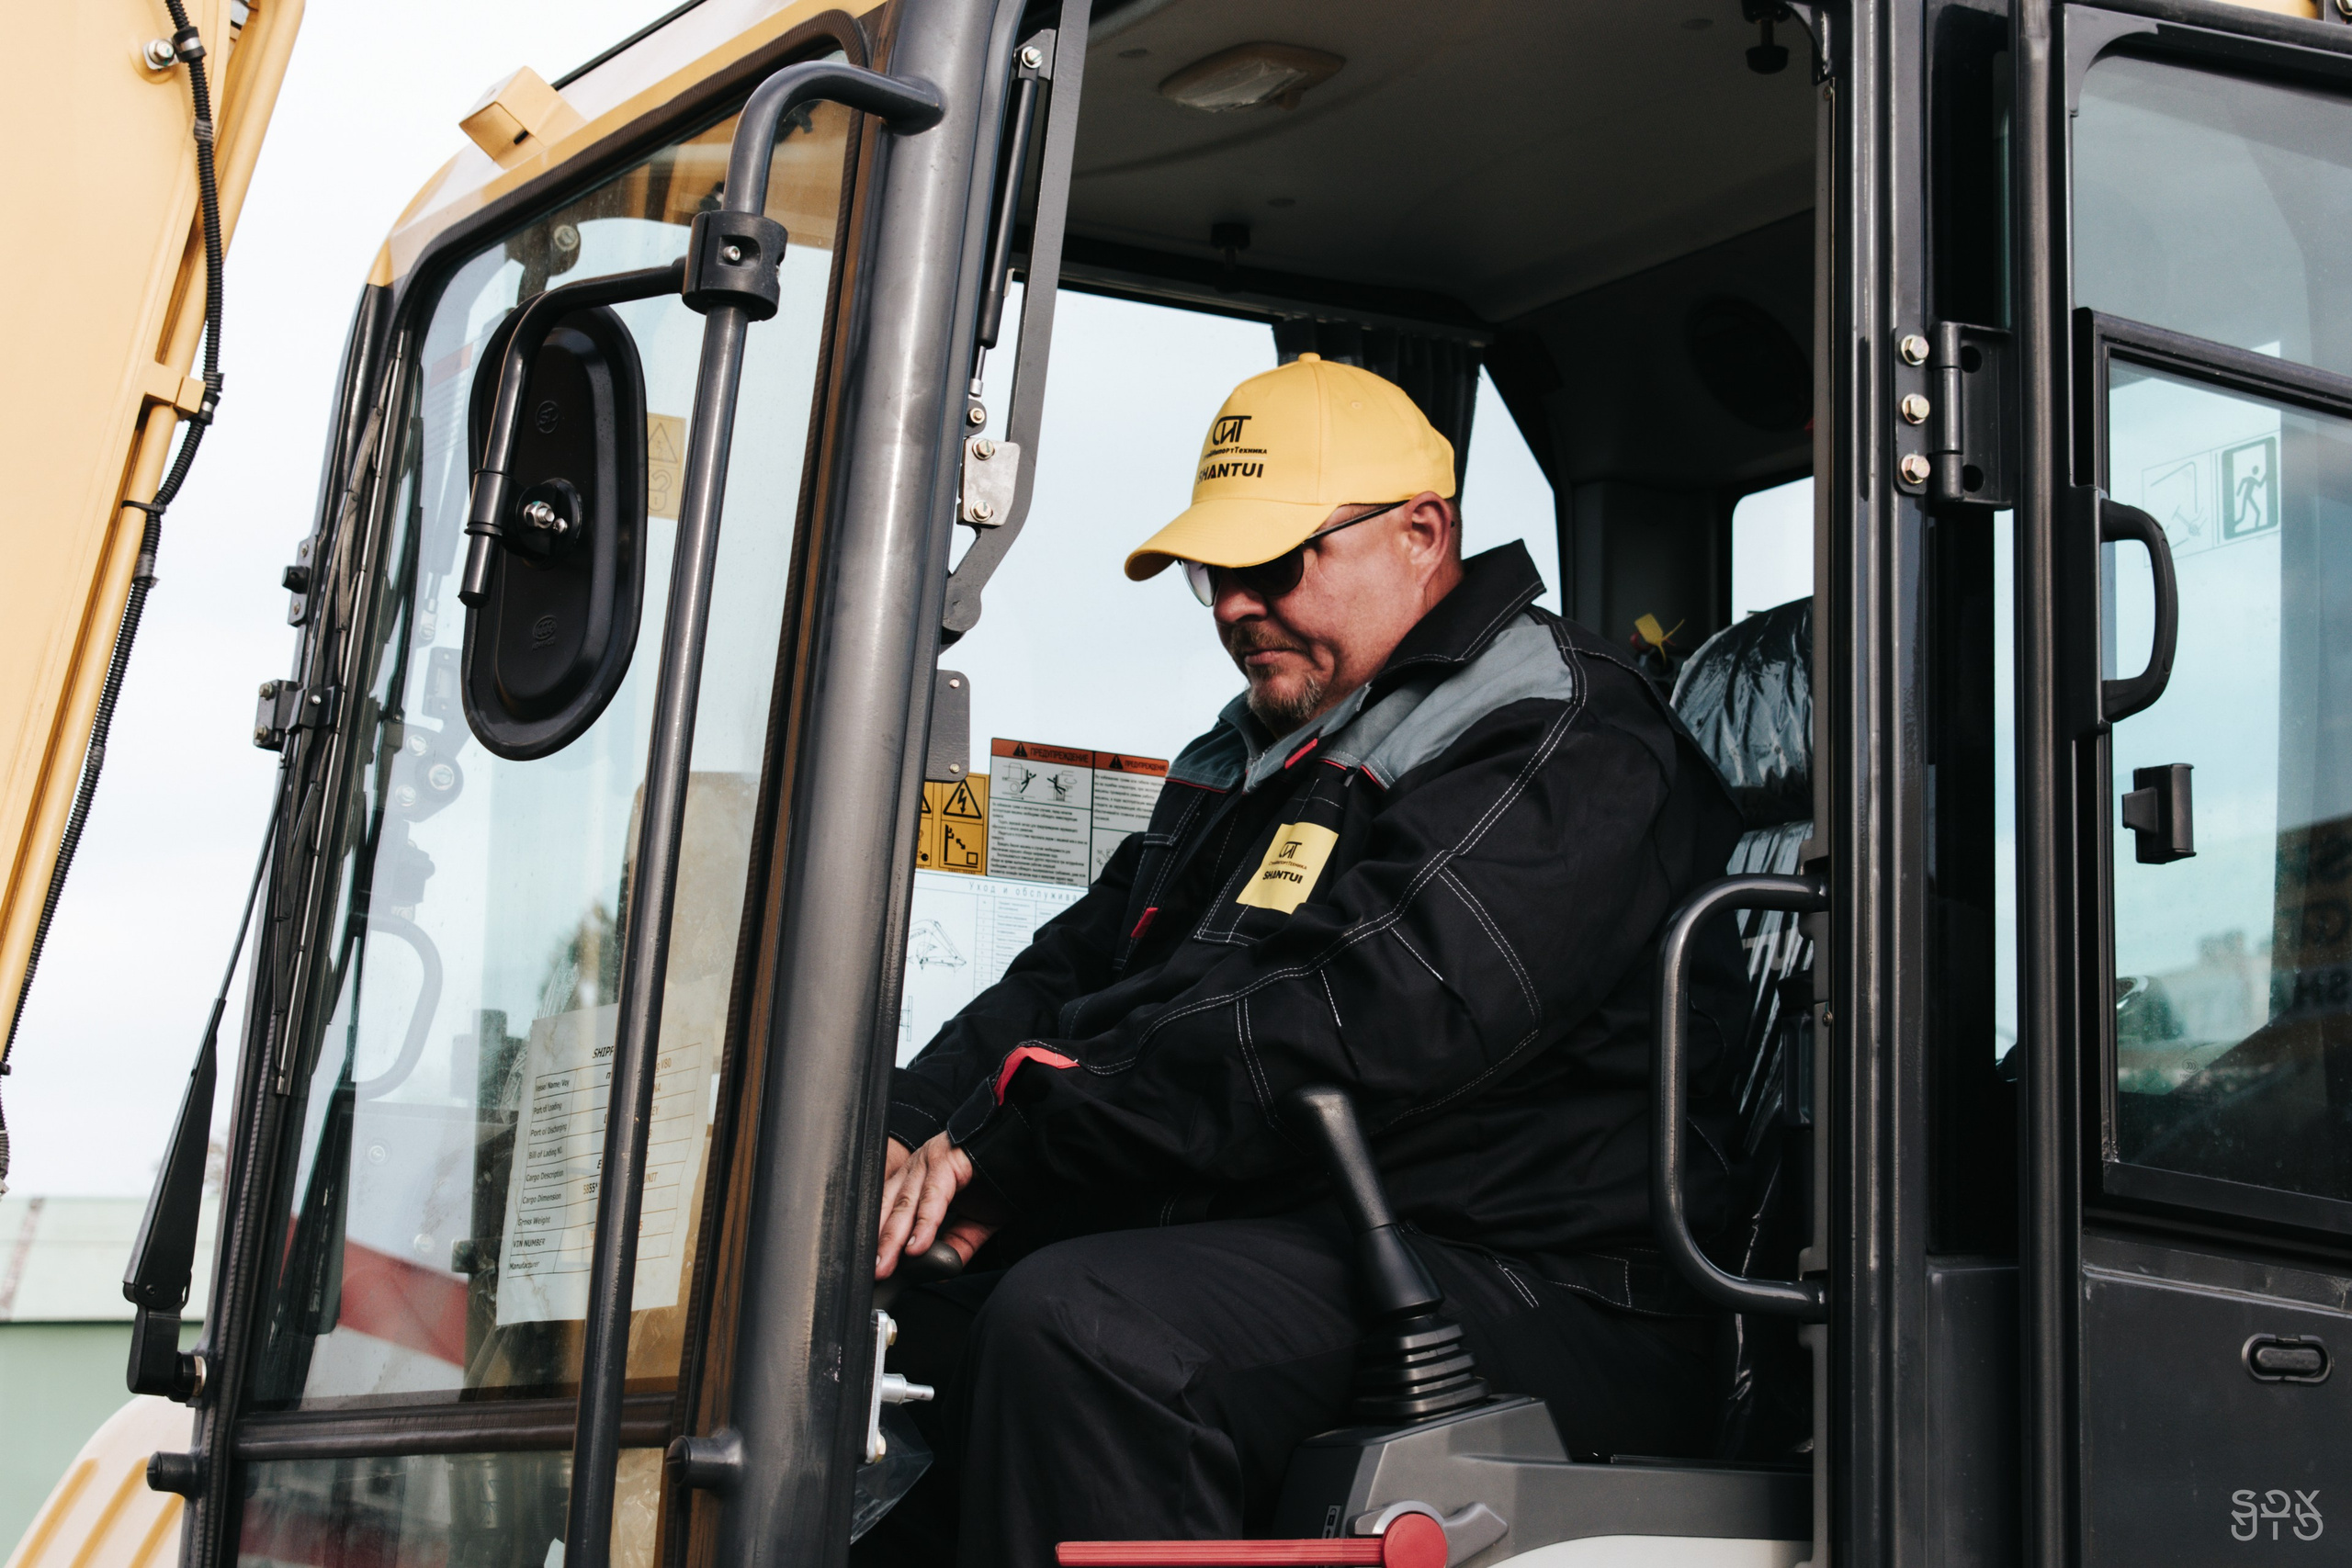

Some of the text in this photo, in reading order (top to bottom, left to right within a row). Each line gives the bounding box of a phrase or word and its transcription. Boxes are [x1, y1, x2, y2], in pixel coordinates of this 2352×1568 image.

[1213, 415, 1252, 446] СИТ
[1197, 462, 1264, 485] SHANTUI
[1030, 748, 1089, 763] ПРЕДУПРЕЖДЕНИЕ
[1125, 760, 1167, 773] ПРЕДУПРЕЖДЕНИЕ
[1262, 869, 1304, 885] SHANTUI
[969, 881, 996, 894] Уход
[533, 1102, 562, 1115] Port of Loading
[530, 1122, 568, 1137] Port of Discharging
[528, 1150, 537, 1159] Bill
[537, 1149, 543, 1158] of
[543, 1147, 557, 1158] Lading
[526, 1169, 564, 1183] Cargo Description
[522, 1192, 562, 1205] Cargo Dimension
[517, 1215, 551, 1227] Gross Weight
[513, 1237, 546, 1248] VIN NUMBER
[508, 1259, 540, 1270] Manufacturer
